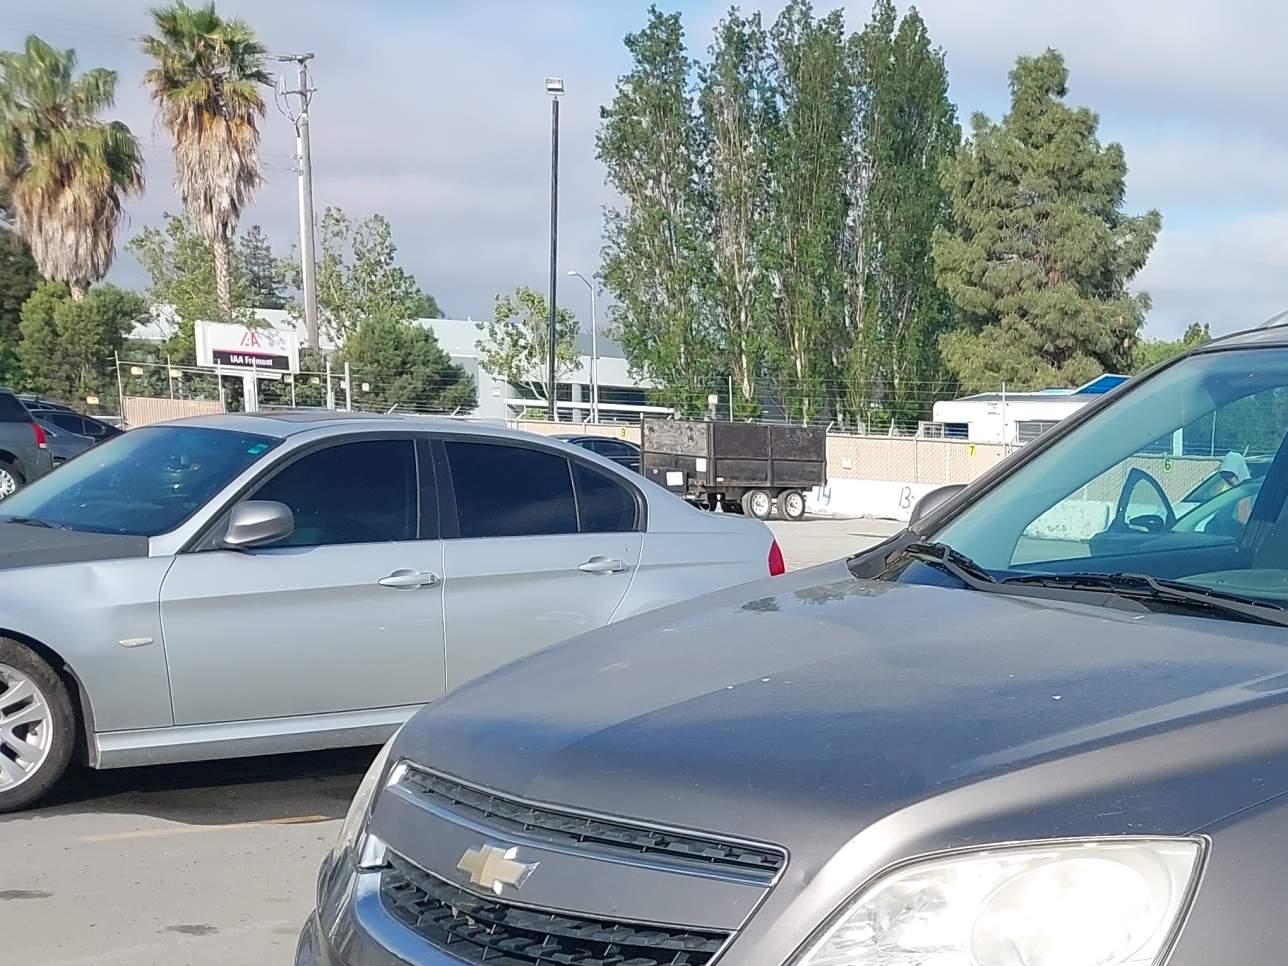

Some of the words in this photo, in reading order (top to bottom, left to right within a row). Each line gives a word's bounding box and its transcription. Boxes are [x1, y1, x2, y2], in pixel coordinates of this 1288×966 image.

[230, 354, 244, 364] IAA
[970, 445, 975, 456] 7
[1164, 459, 1171, 471] 6
[816, 486, 831, 506] 14
[899, 486, 912, 509] 13
